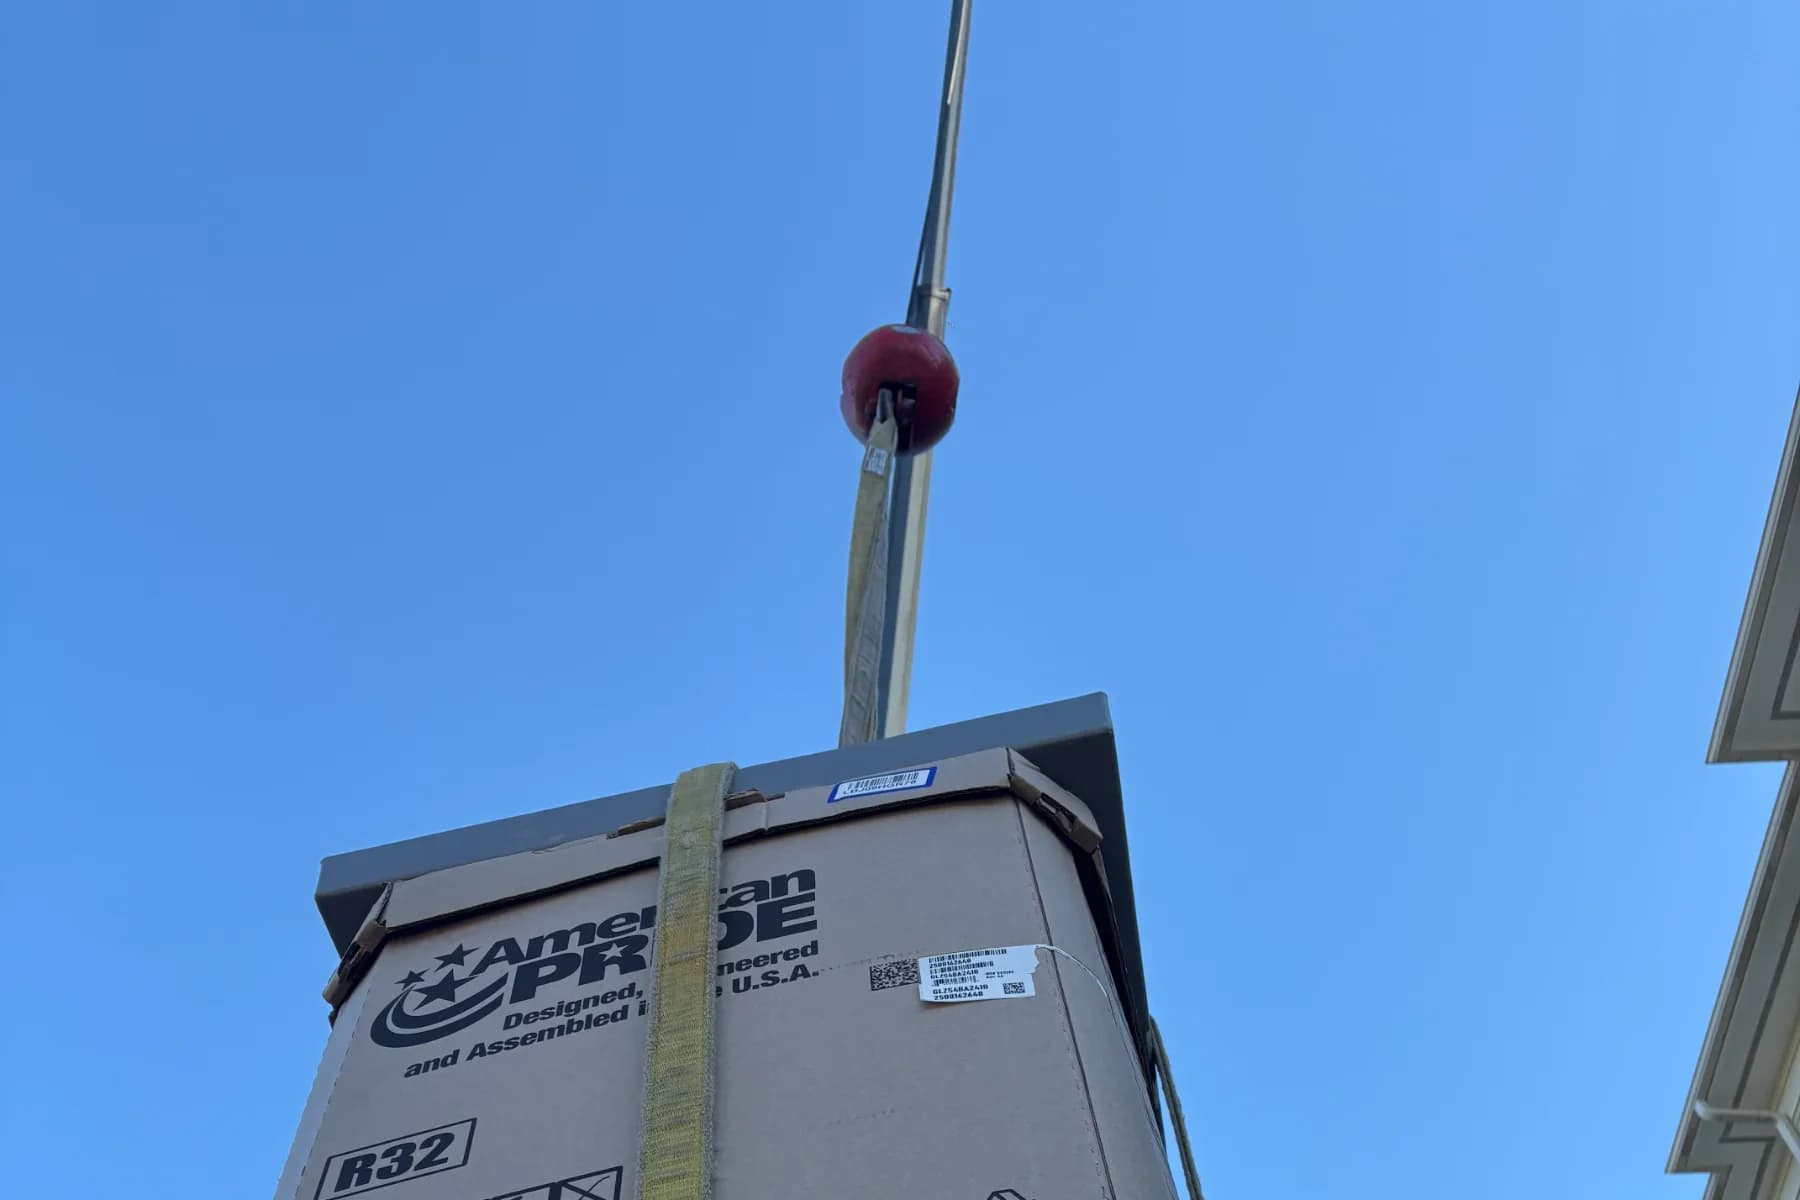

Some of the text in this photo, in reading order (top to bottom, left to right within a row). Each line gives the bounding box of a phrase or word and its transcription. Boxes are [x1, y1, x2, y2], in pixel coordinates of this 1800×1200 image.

[469, 869, 816, 976] Ameran
[509, 892, 817, 1004] PRDE
[403, 1050, 460, 1078] and
[466, 1004, 629, 1061] Assembled
[732, 964, 819, 993] U.S.A.
[502, 982, 643, 1031] Designed,
[334, 1132, 456, 1192] R32
